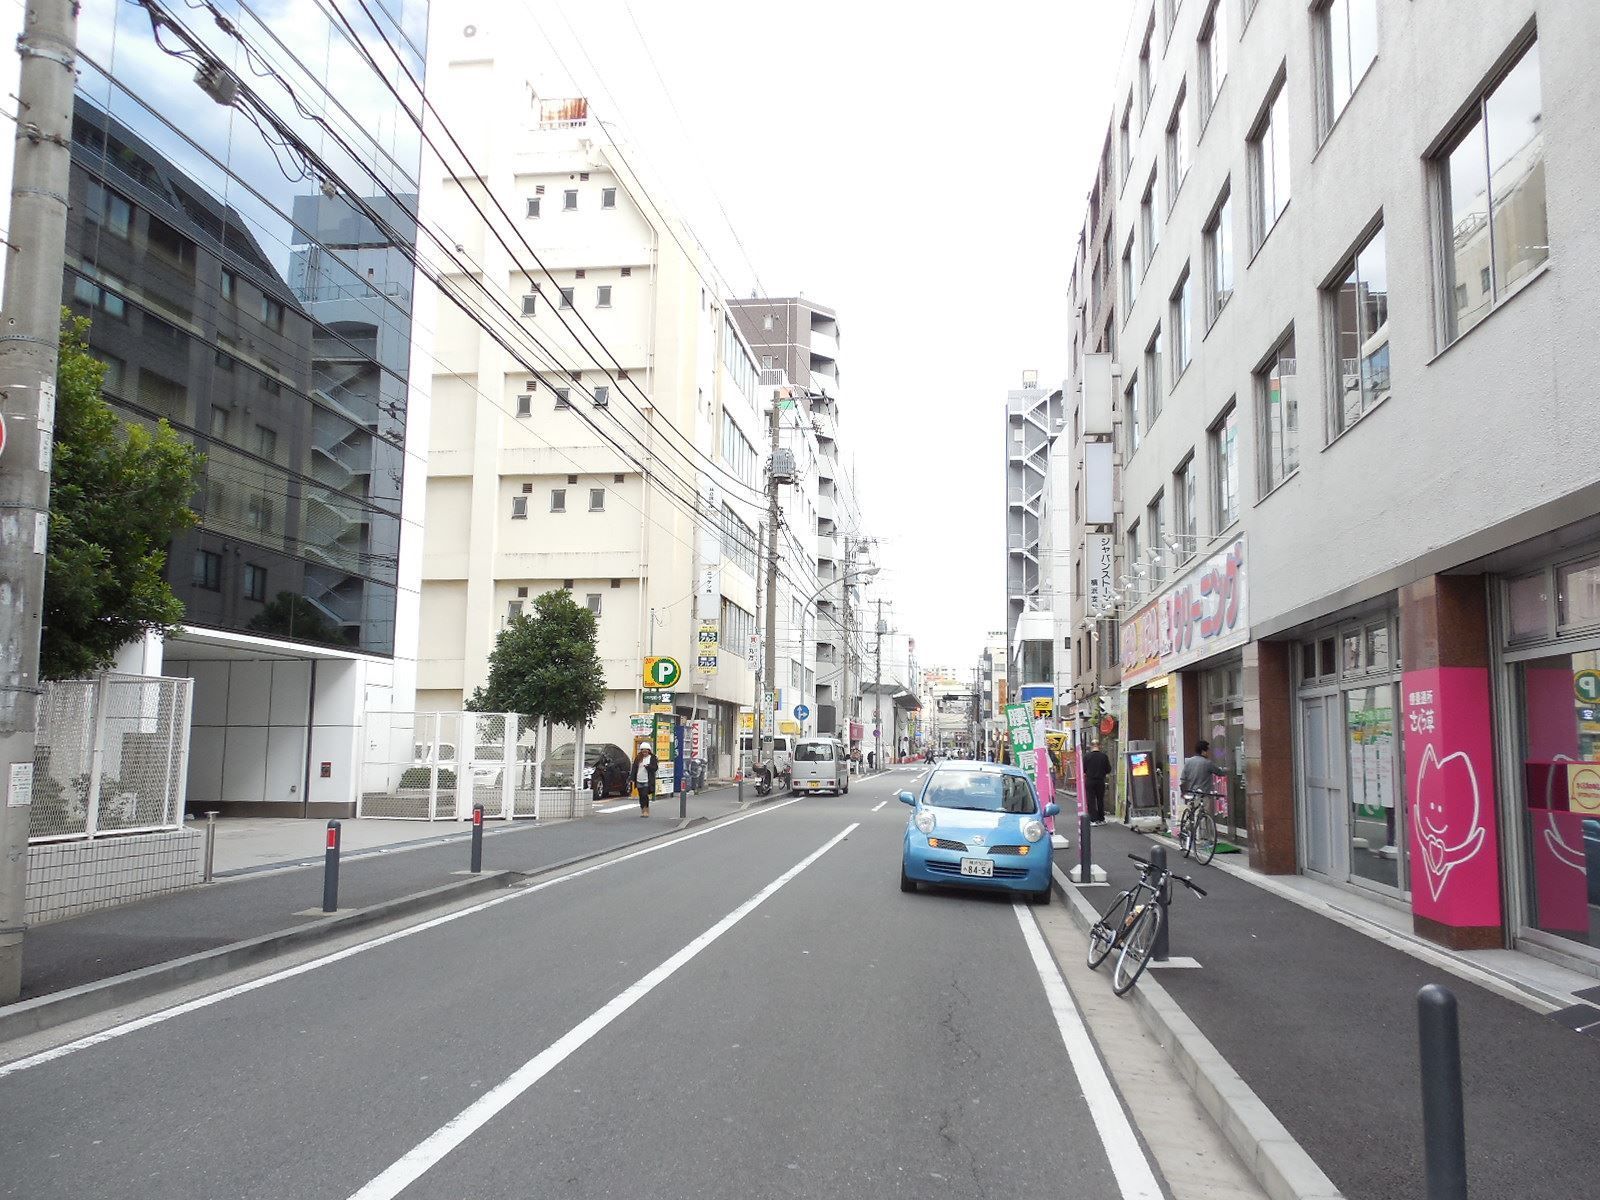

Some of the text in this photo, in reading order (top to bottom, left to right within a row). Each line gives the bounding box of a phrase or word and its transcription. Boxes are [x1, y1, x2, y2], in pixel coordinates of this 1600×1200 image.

[1174, 541, 1243, 653] クリーニング
[659, 663, 674, 683] P
[1008, 707, 1035, 773] 腰痛・肩
[968, 865, 991, 875] 84-54
